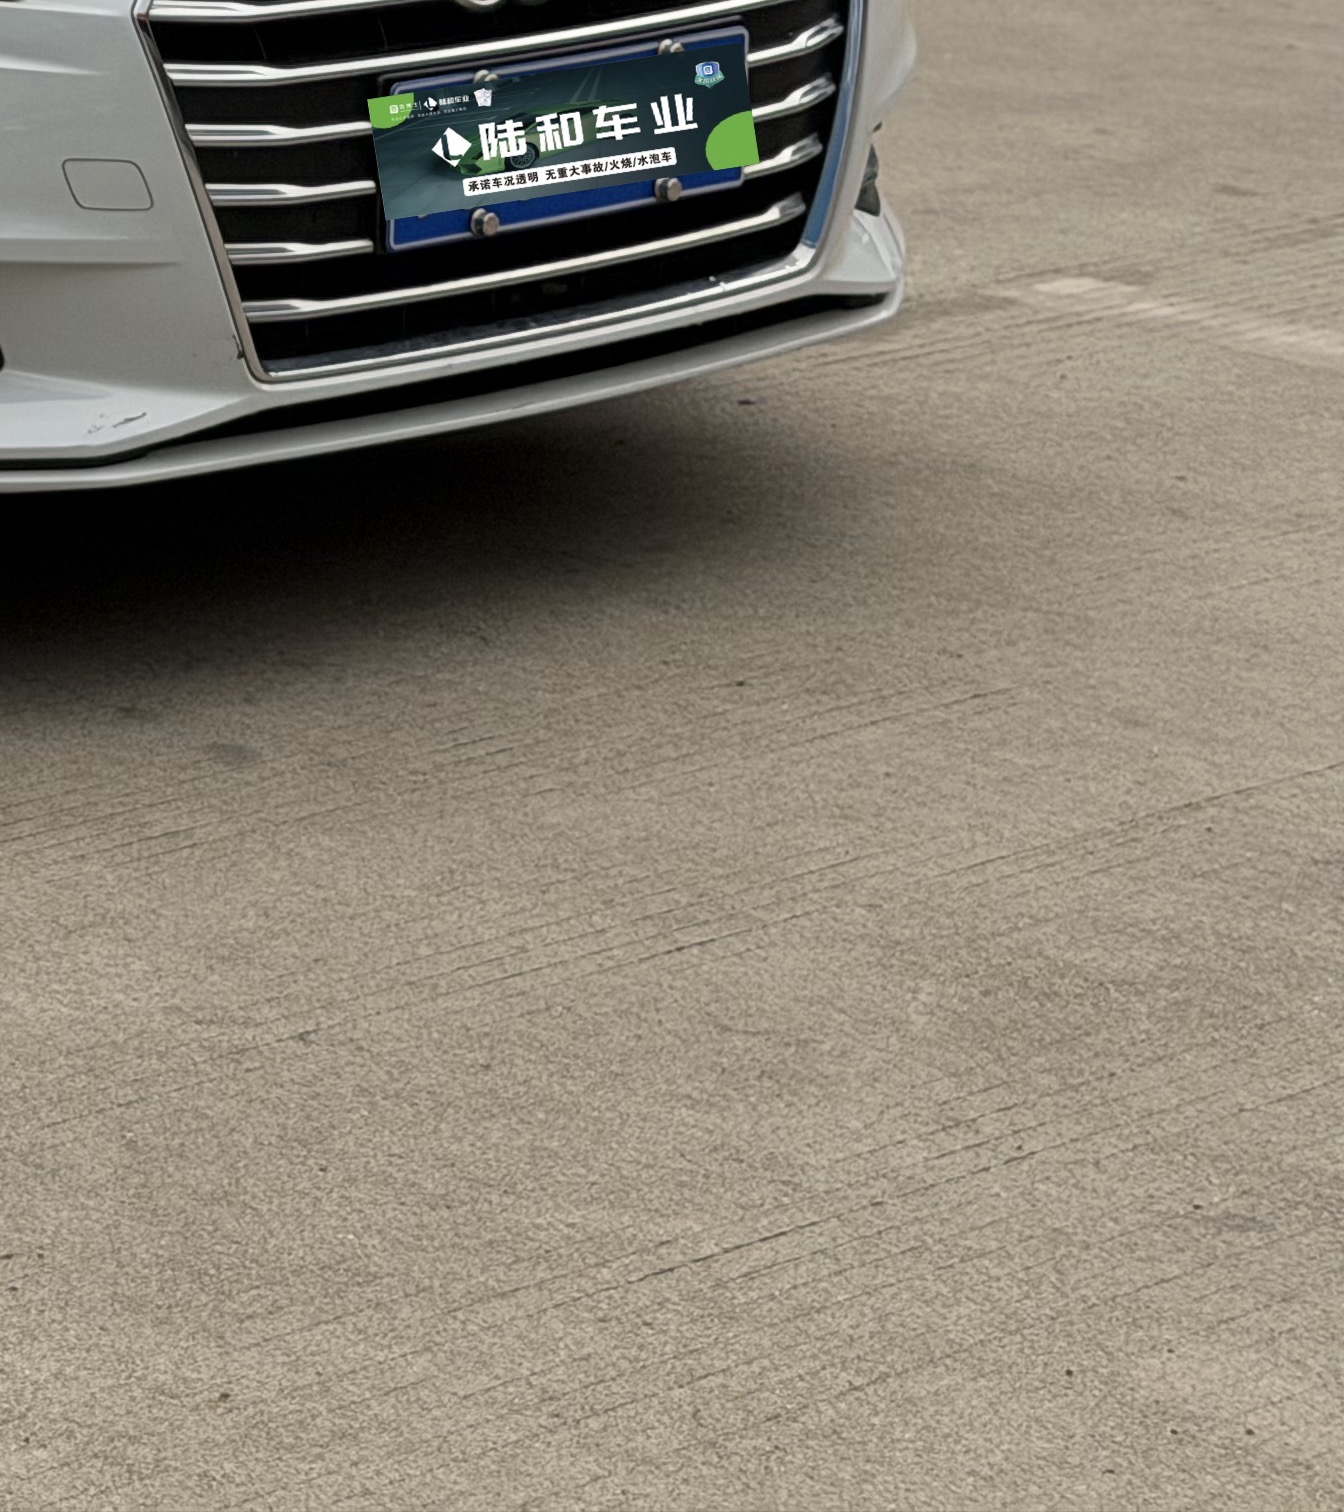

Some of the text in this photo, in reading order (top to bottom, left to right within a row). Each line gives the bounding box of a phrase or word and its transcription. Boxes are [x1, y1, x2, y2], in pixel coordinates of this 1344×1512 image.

[478, 93, 699, 161] 陆和车业
[467, 150, 673, 193] 承诺车况透明 无重大事故/火烧/水泡车
